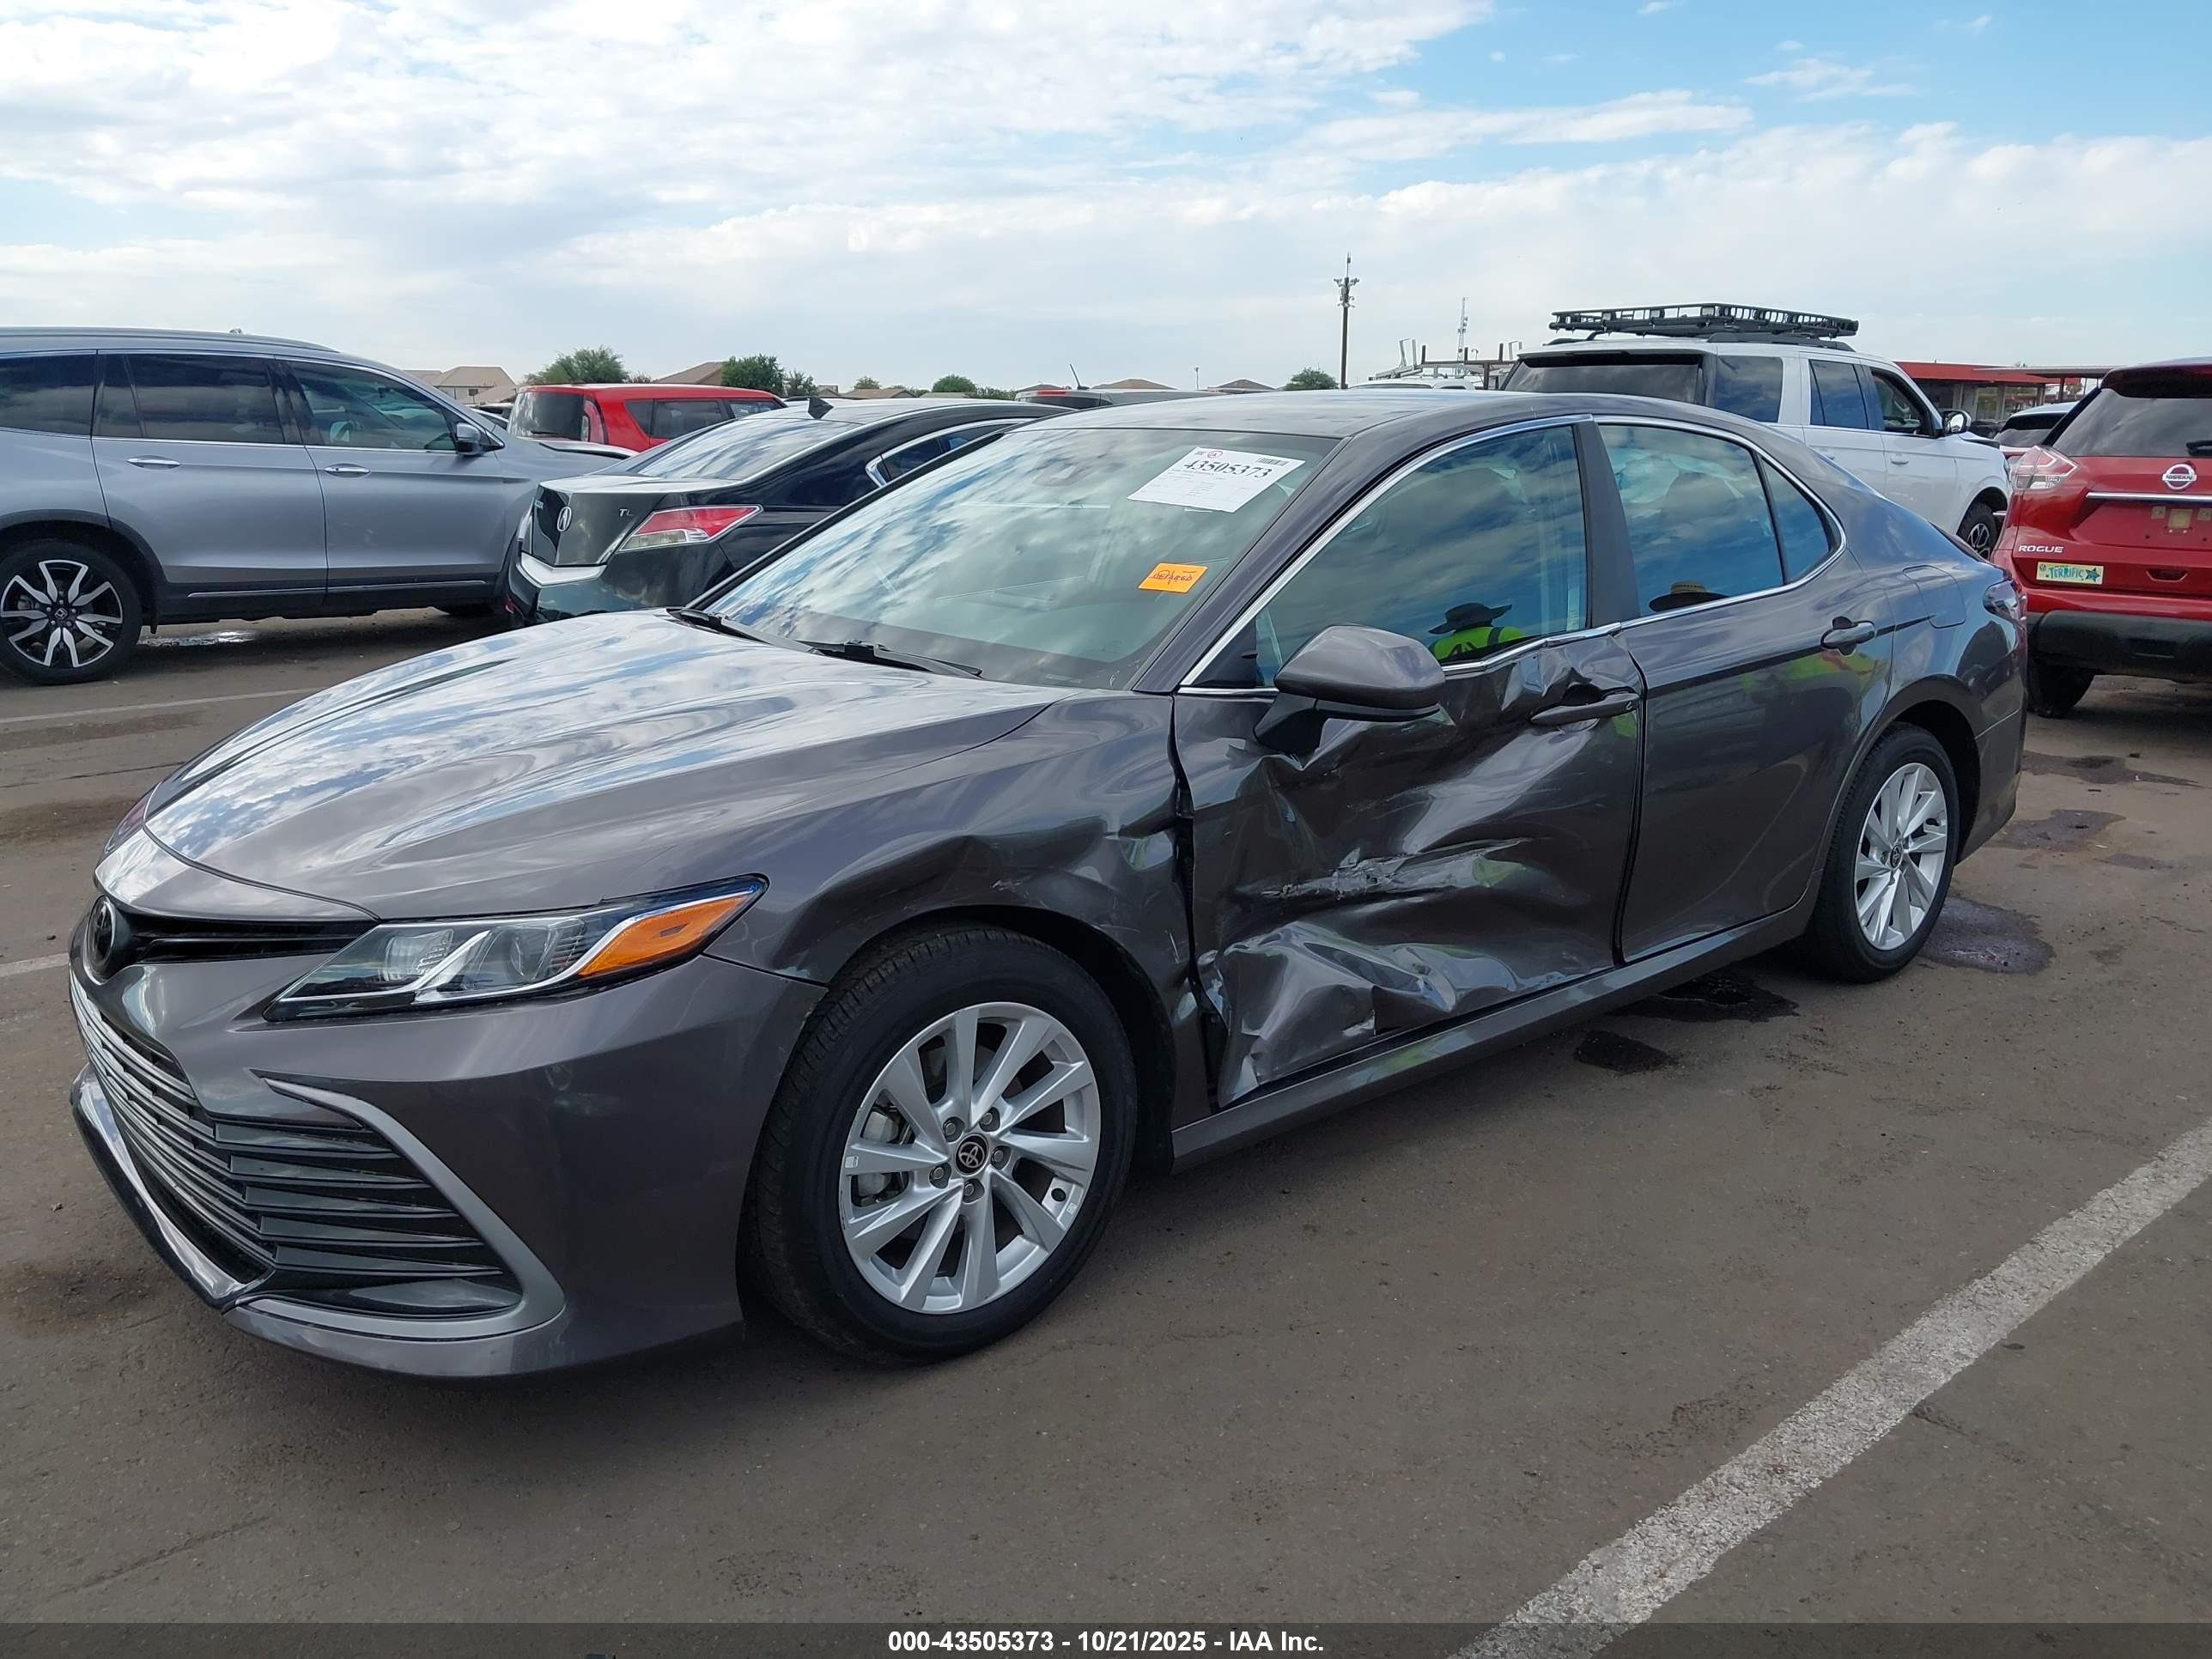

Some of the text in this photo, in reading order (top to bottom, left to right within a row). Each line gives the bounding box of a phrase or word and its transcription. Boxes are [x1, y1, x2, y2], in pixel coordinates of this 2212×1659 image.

[1184, 459, 1273, 477] 43505373
[619, 508, 633, 517] TL
[2018, 544, 2064, 553] ROGUE
